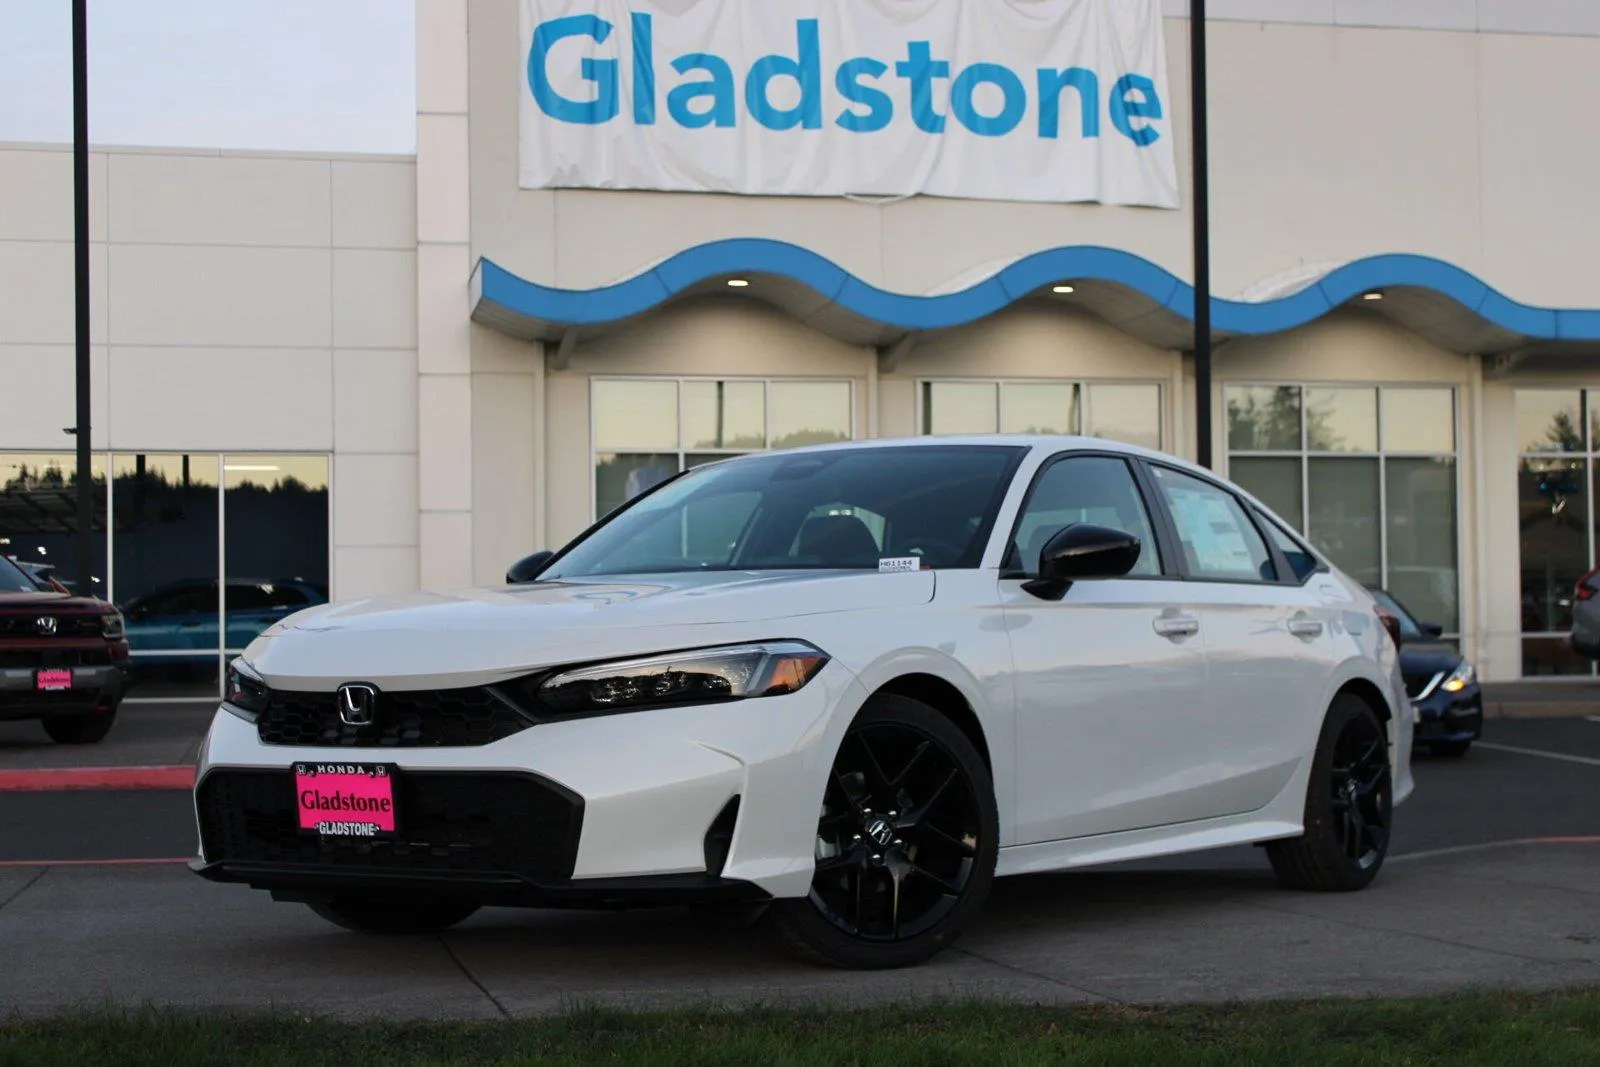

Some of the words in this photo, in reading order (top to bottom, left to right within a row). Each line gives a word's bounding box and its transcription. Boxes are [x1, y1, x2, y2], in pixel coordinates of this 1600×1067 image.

[527, 12, 1163, 147] Gladstone
[317, 765, 365, 775] HONDA
[300, 789, 391, 812] Gladstone
[319, 821, 375, 836] GLADSTONE
